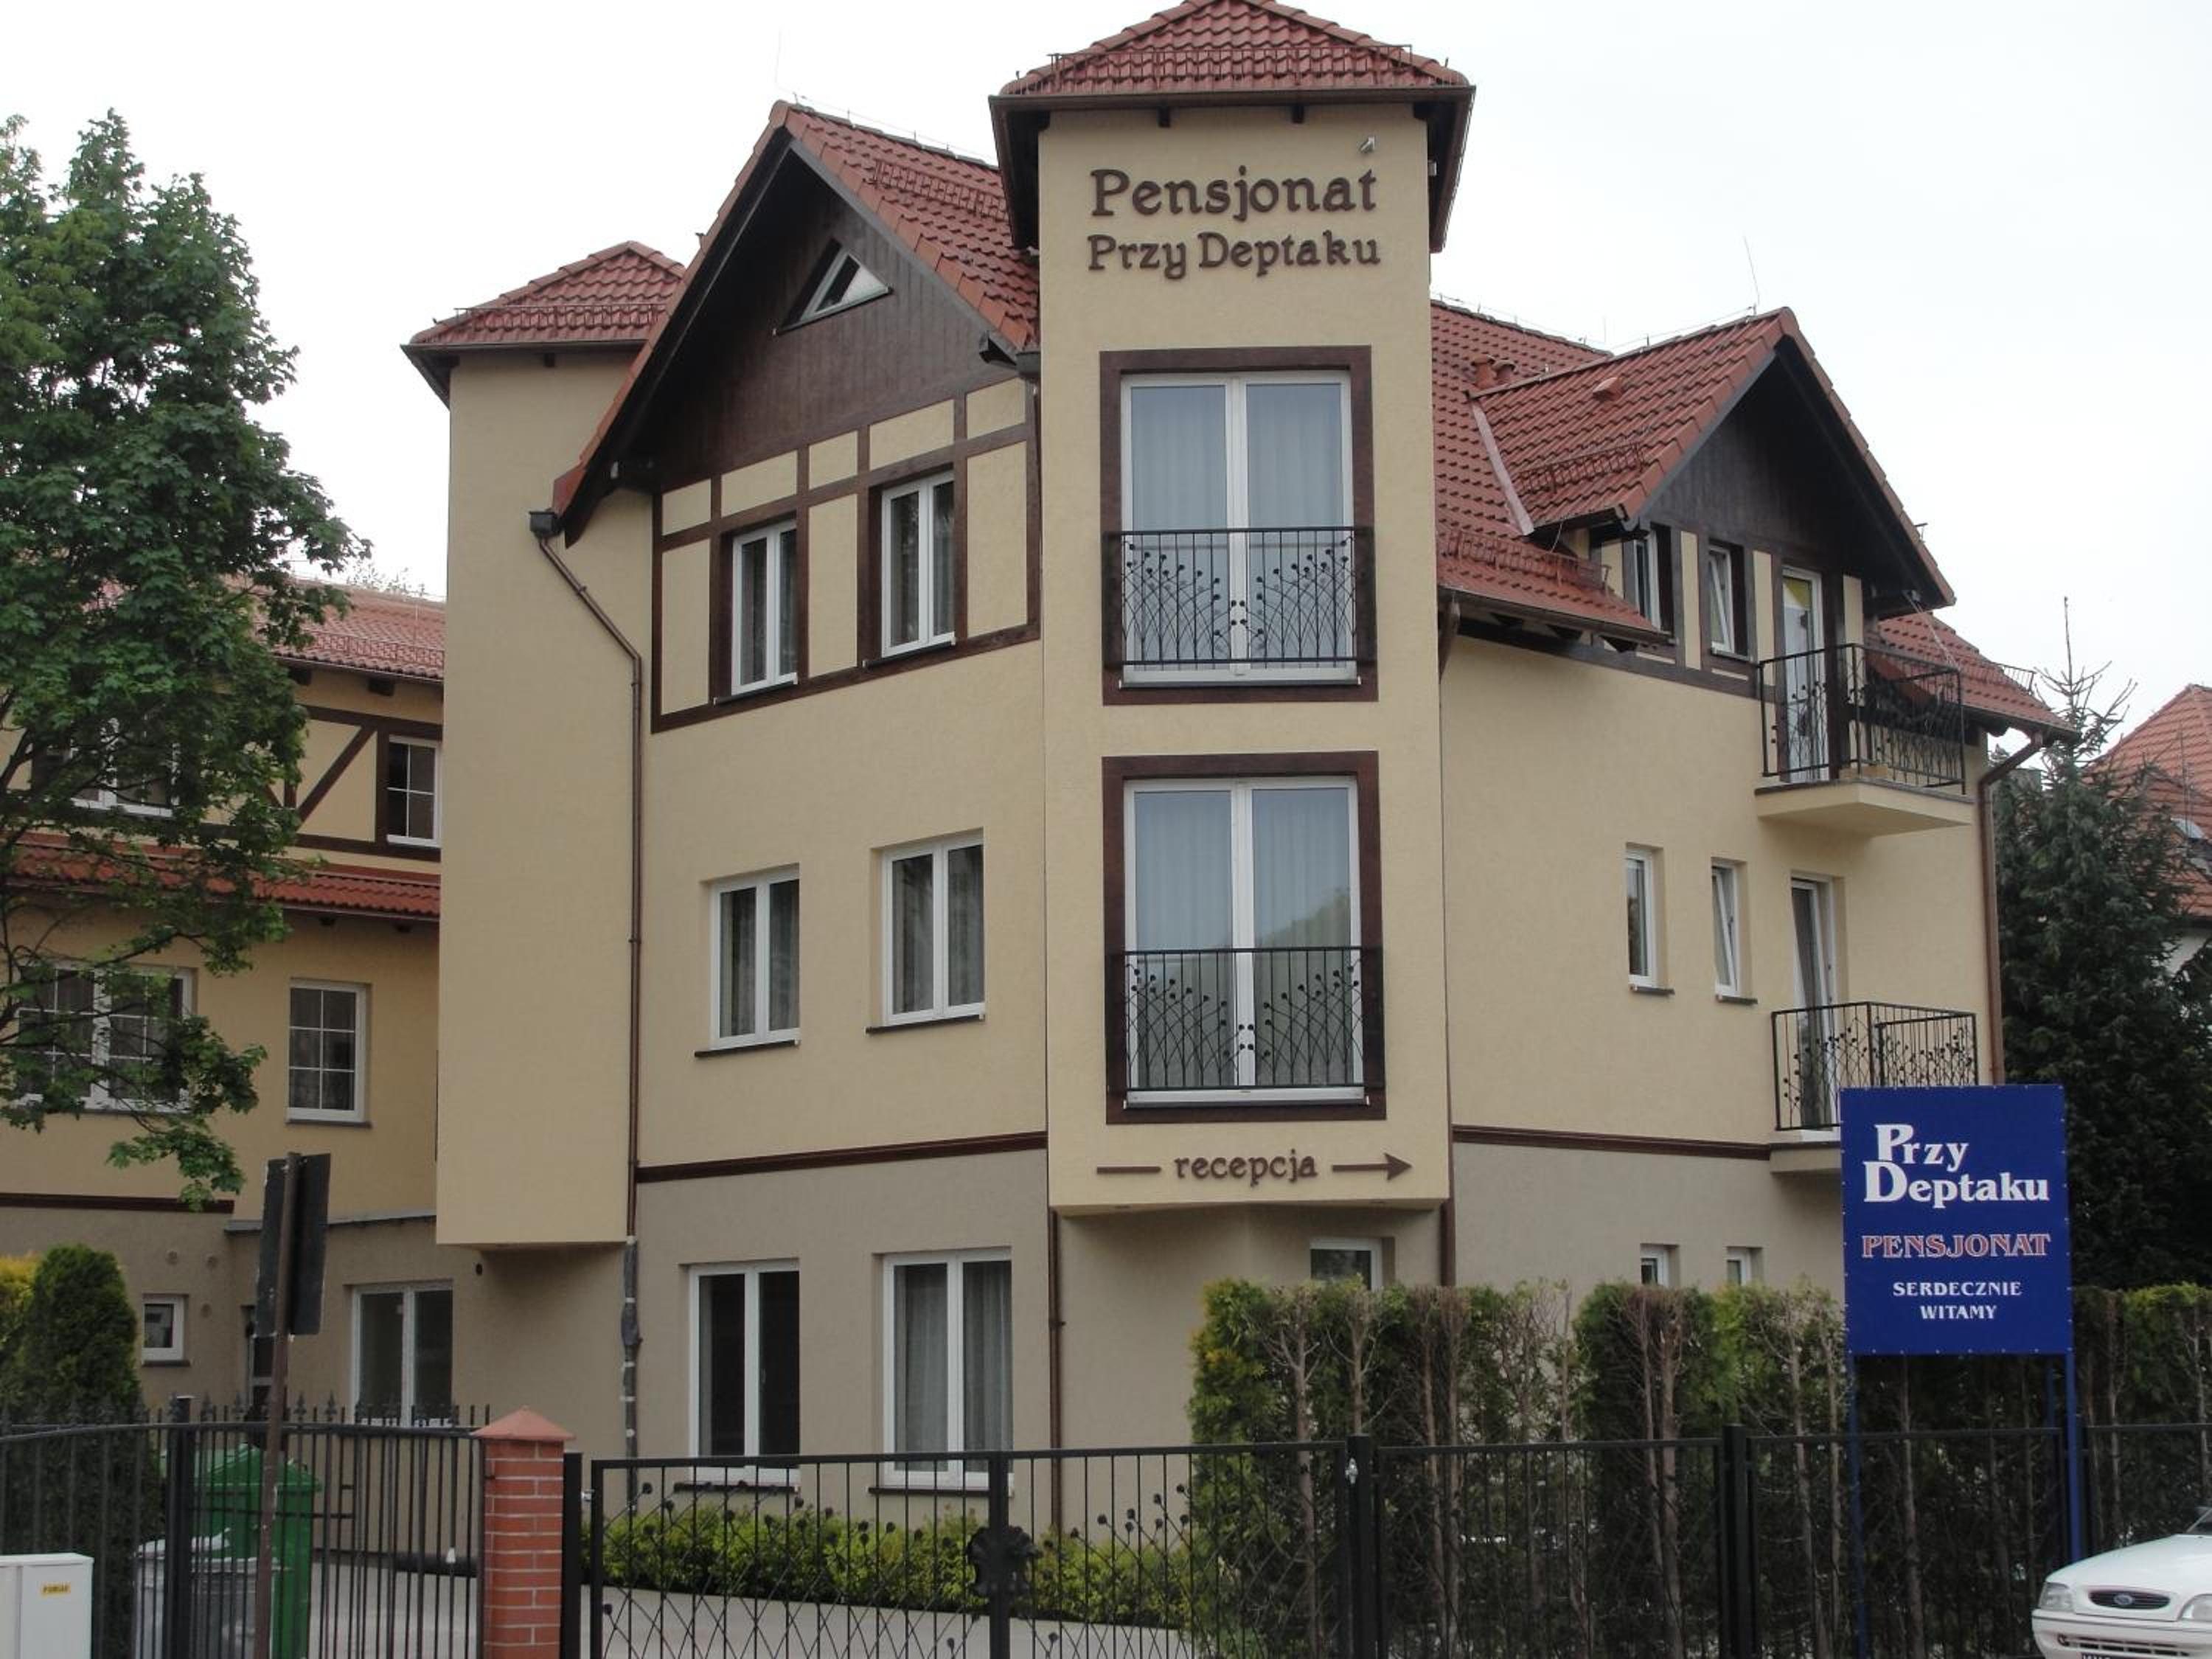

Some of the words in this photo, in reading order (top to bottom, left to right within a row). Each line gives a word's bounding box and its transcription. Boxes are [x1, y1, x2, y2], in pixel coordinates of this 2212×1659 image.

[1090, 165, 1377, 221] Pensjonat
[1088, 234, 1187, 279] Przy
[1197, 231, 1380, 276] Deptaku
[1174, 1149, 1318, 1187] recepcja
[1874, 1124, 1969, 1172] Przy
[1863, 1161, 2050, 1208] Deptaku
[1862, 1234, 2051, 1258] PENSJONAT
[1893, 1282, 2022, 1295] SERDECZNIE
[1920, 1305, 1997, 1319] WITAMY
